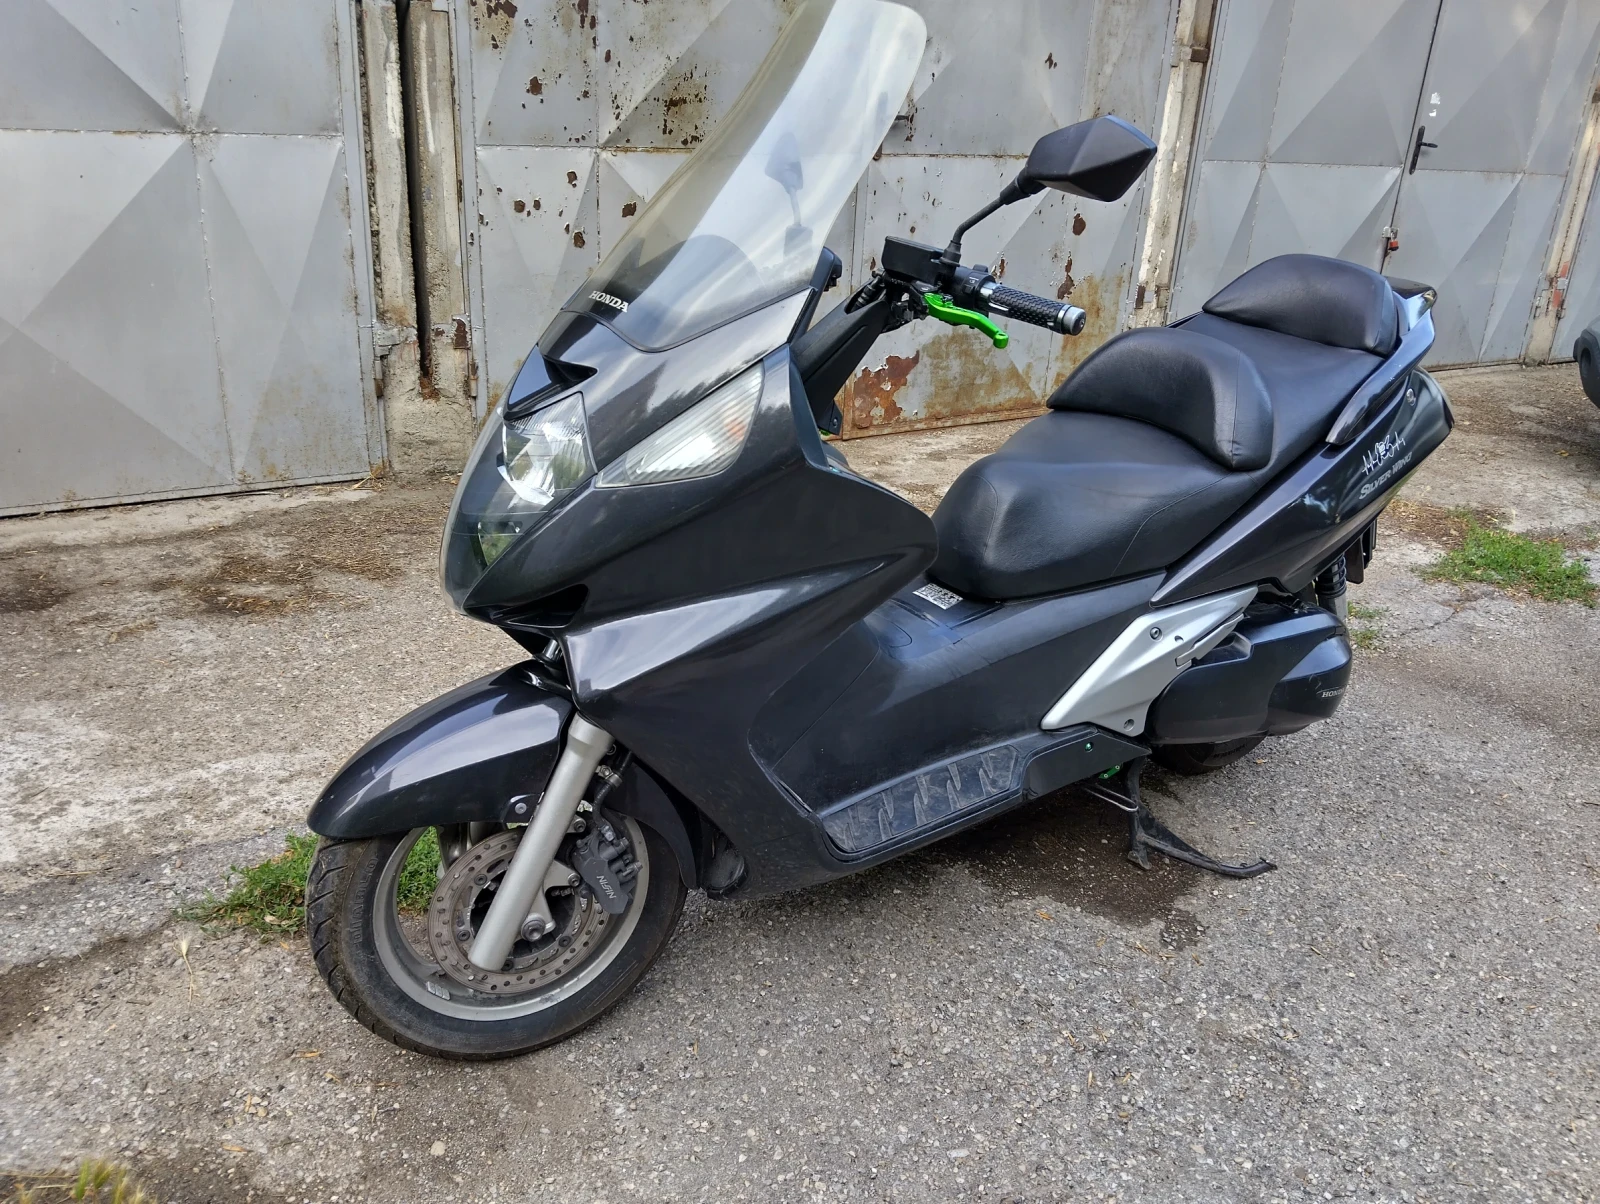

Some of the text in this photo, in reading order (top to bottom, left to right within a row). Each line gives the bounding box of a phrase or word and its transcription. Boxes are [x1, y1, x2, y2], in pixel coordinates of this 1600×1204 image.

[588, 290, 629, 313] HONDA
[1359, 469, 1392, 499] SILVER
[596, 875, 617, 899] NISSIN
[351, 858, 379, 944] DIABLO
